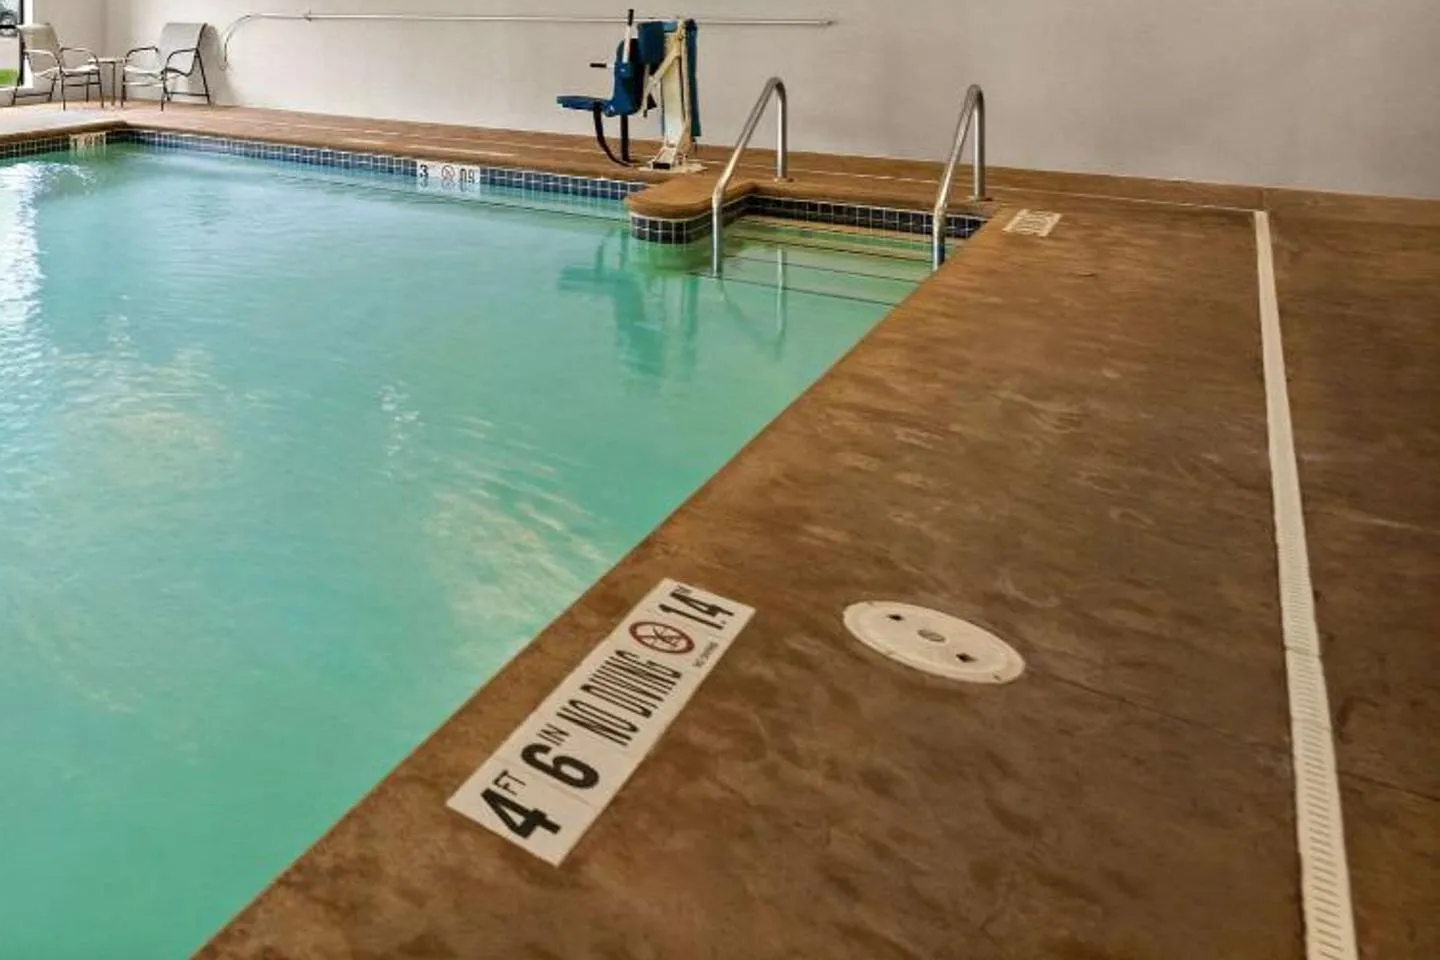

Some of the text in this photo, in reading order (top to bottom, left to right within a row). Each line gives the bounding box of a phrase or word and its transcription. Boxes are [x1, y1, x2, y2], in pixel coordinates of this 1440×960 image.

[580, 650, 682, 718] DIVING
[536, 722, 570, 746] IN
[556, 699, 638, 746] NO
[492, 769, 526, 795] FT
[521, 743, 600, 789] 6
[480, 788, 562, 838] 4
